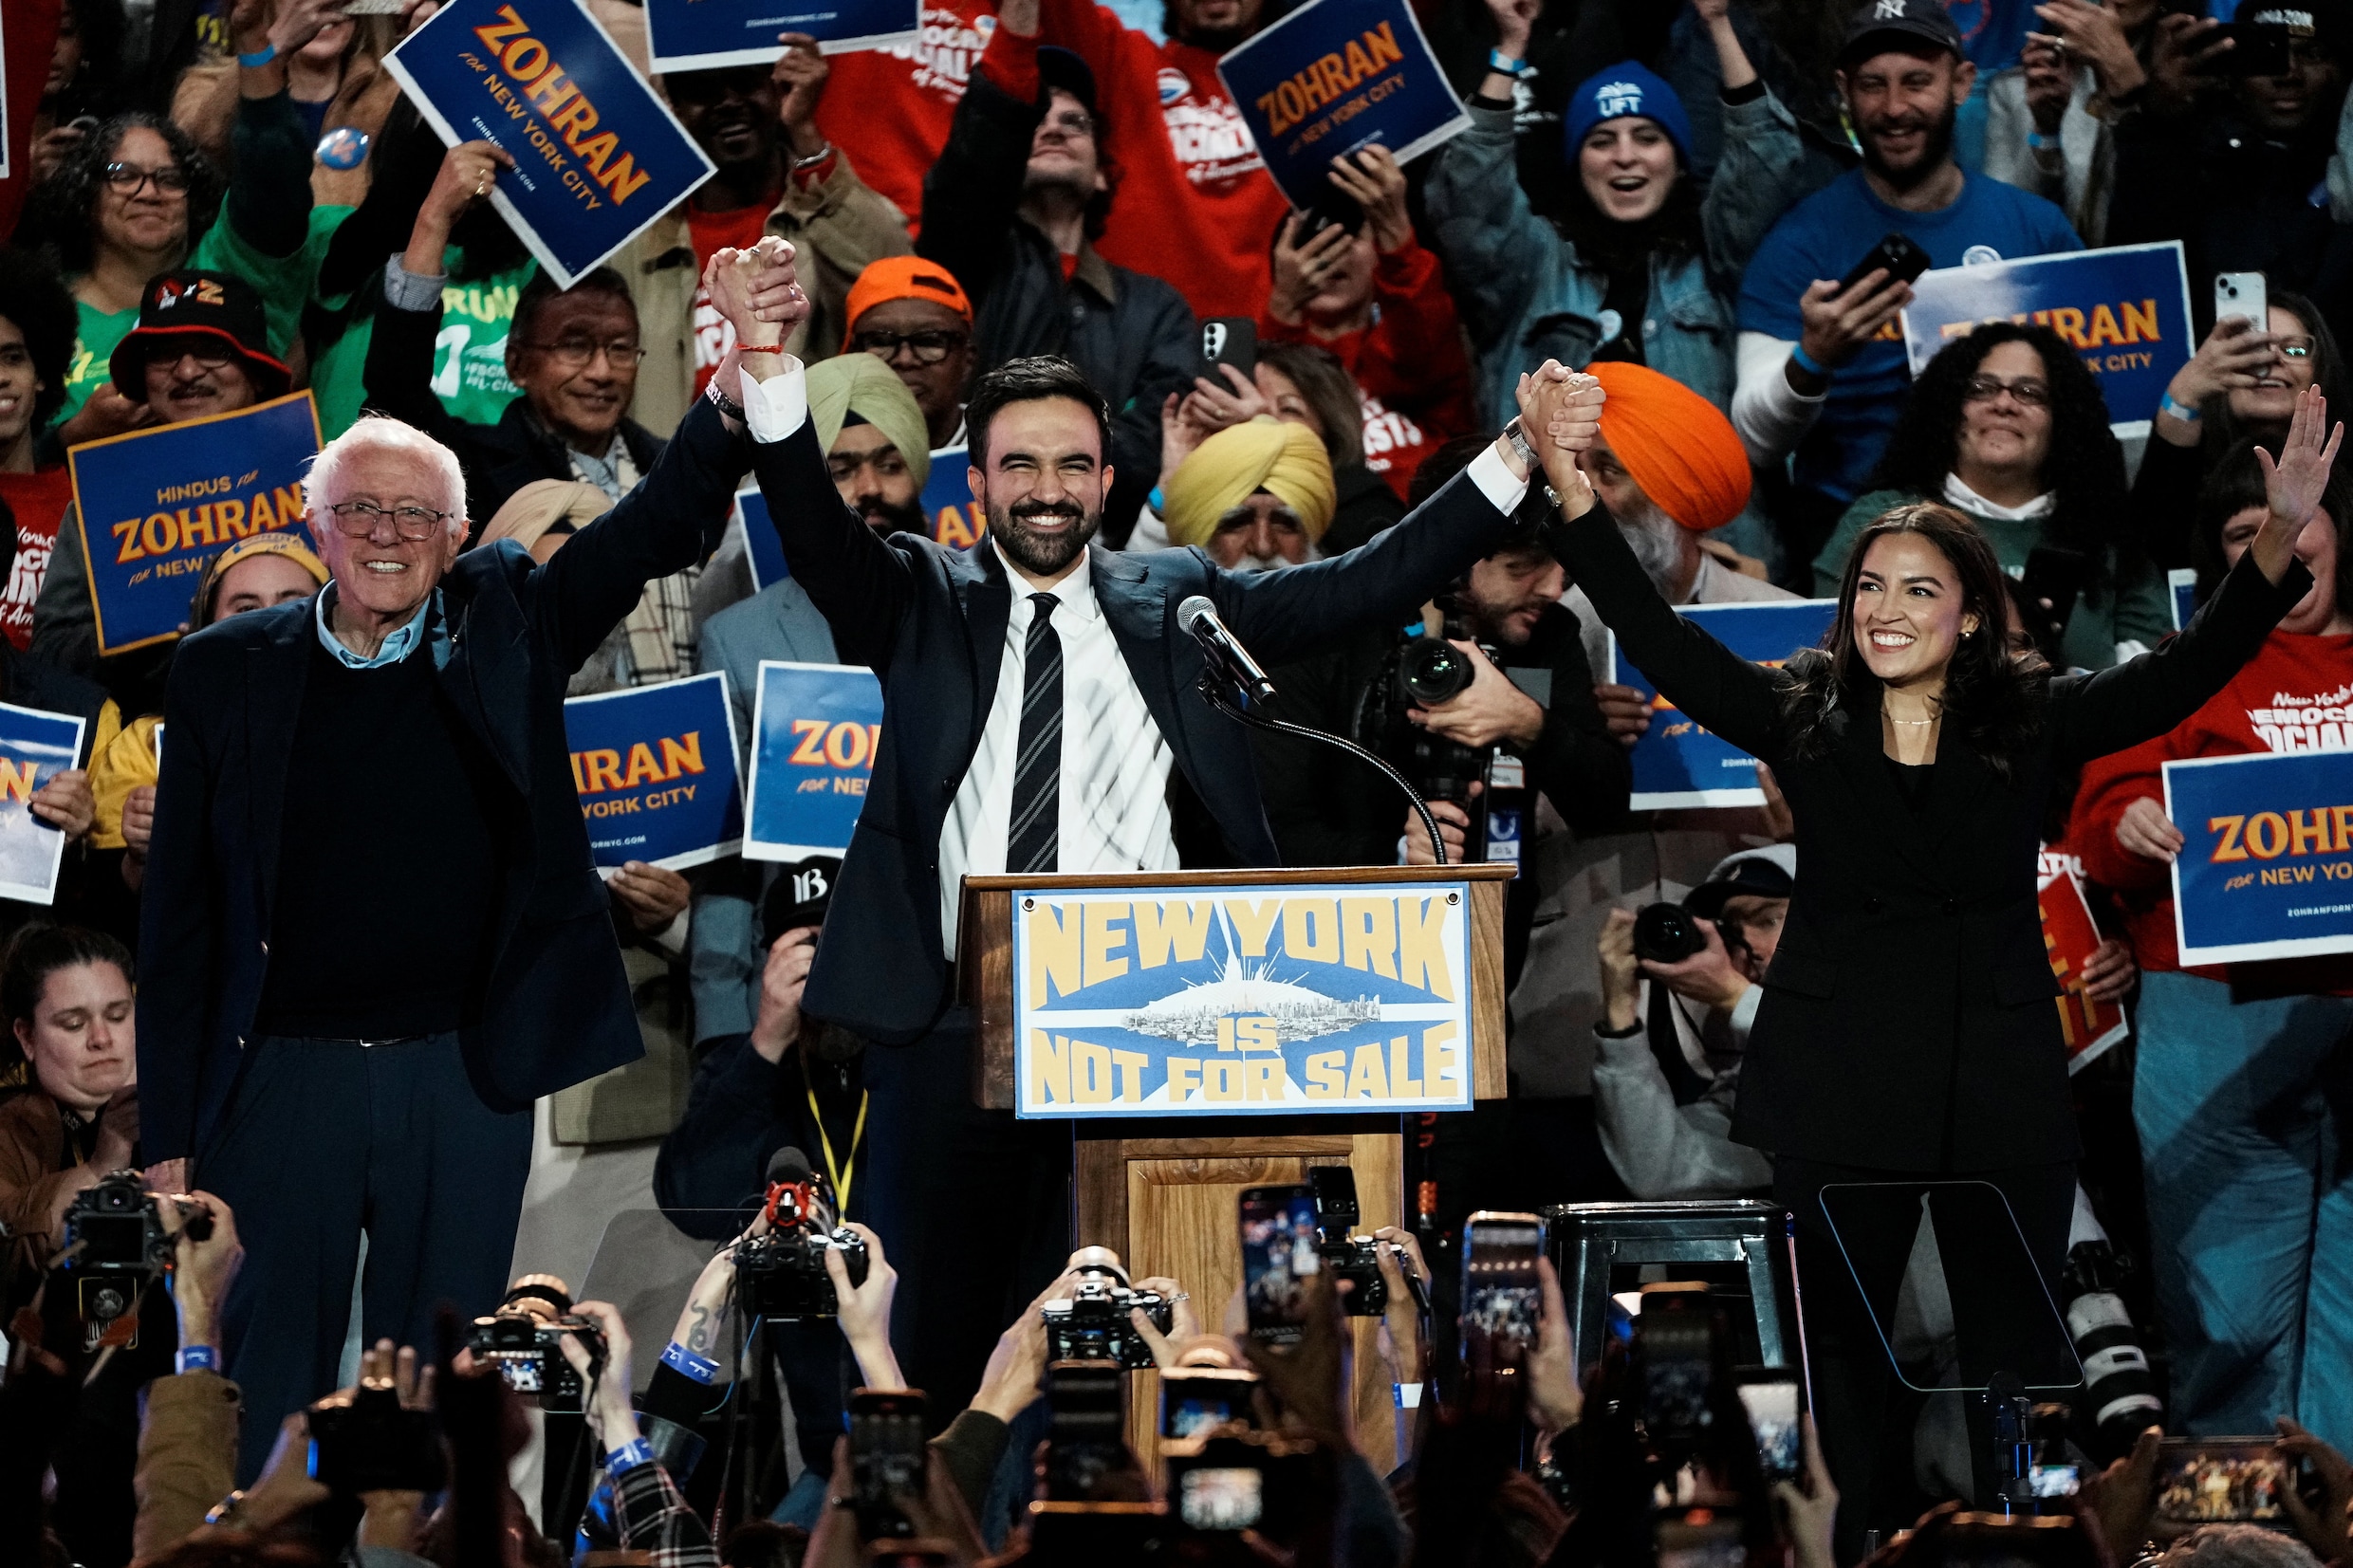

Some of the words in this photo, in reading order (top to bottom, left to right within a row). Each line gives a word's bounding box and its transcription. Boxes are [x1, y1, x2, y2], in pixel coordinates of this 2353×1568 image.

[472, 4, 652, 206] ZOHRAN
[1256, 20, 1404, 138] ZOHRAN
[483, 74, 527, 120] NEW
[522, 118, 567, 173] YORK
[562, 170, 602, 212] CITY
[2105, 352, 2153, 374] CITY
[157, 476, 232, 505] HINDUS
[236, 470, 259, 489] FOR
[111, 482, 306, 564] ZOHRAN
[128, 569, 152, 588] FOR
[156, 556, 204, 578] NEW
[581, 795, 641, 820] YORK
[645, 785, 697, 809] CITY
[2260, 864, 2315, 886] NEW
[1028, 899, 1214, 1011] NEW
[1223, 895, 1455, 1004] YORK
[1030, 1027, 1149, 1105] NOT
[1166, 1055, 1286, 1102] FOR
[1305, 1019, 1458, 1099] SALE
[1217, 1016, 1277, 1052] IS
